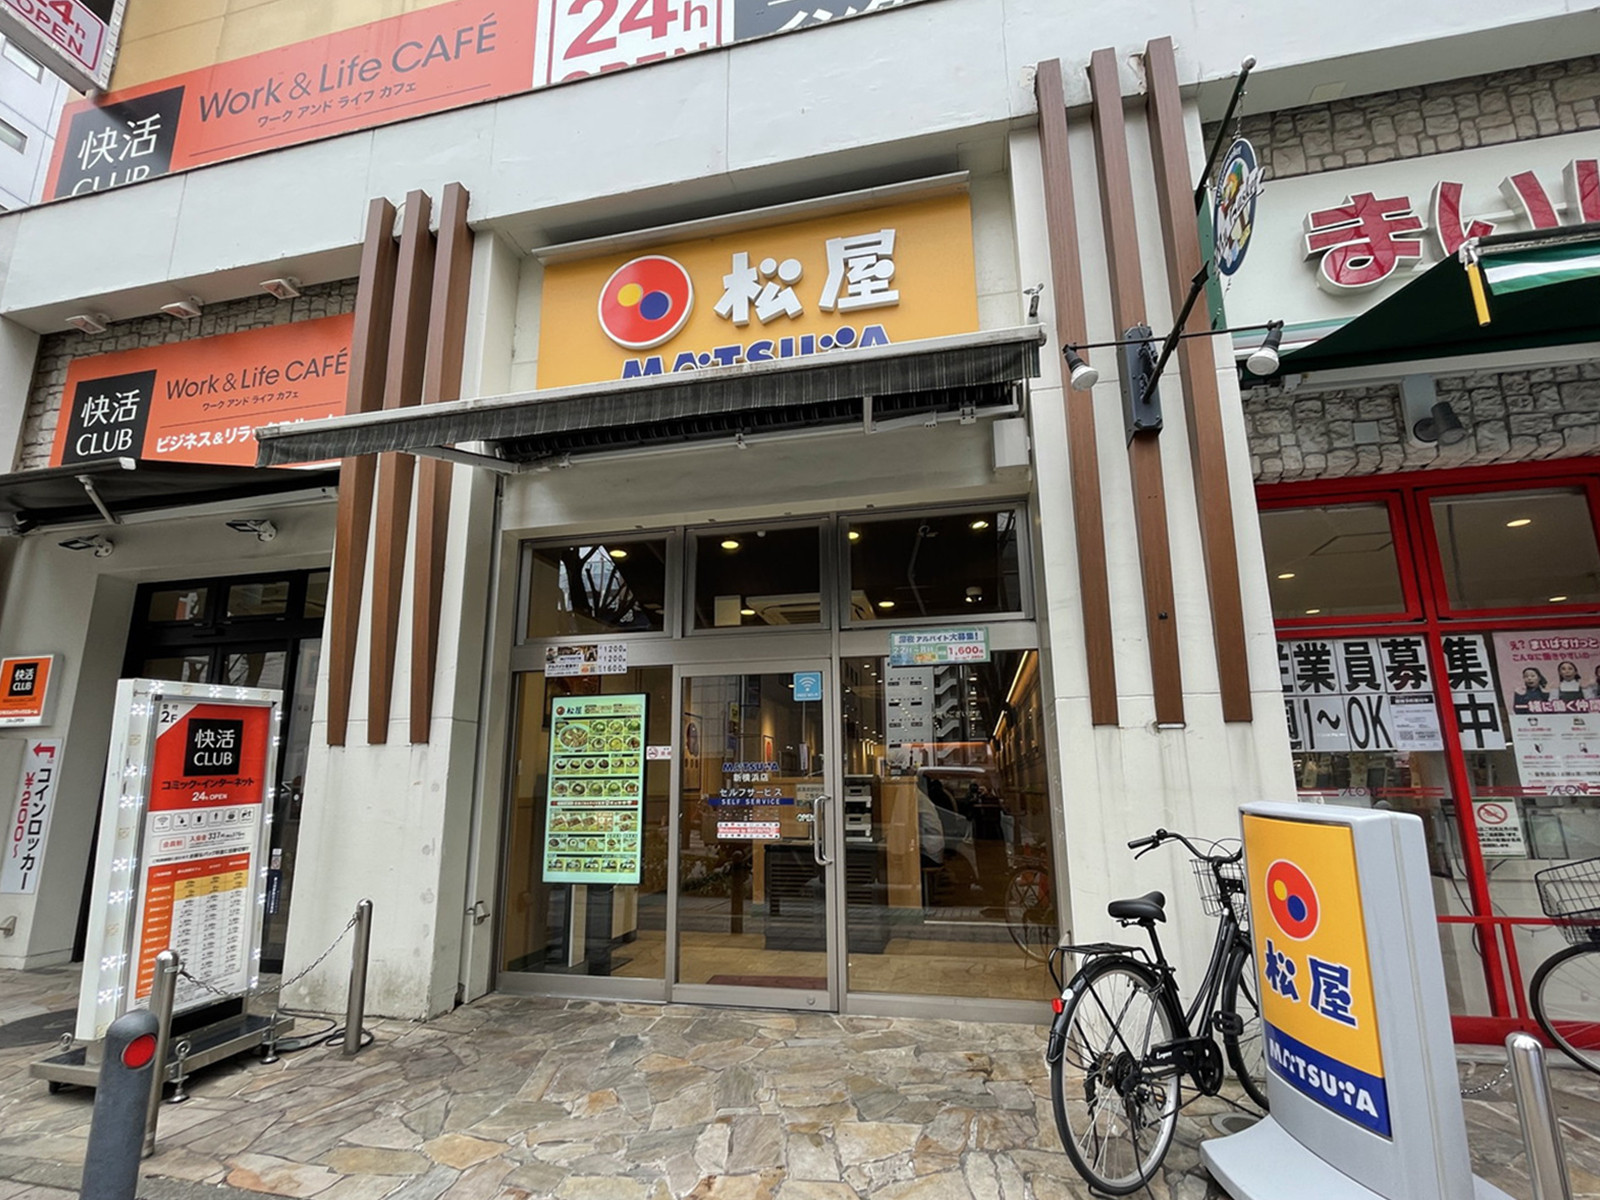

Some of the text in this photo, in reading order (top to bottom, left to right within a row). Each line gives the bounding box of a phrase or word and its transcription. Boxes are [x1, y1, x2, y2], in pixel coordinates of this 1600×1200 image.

[17, 0, 83, 55] OPEN
[36, 0, 86, 39] 4h
[563, 0, 708, 60] 24h
[200, 12, 497, 122] Work & Life CAFÉ
[258, 82, 416, 127] ワーク アンド ライフ カフェ
[77, 113, 161, 171] 快活
[1303, 158, 1600, 296] まい
[713, 228, 901, 328] 松屋
[166, 347, 348, 400] Work & Life CAFÉ
[80, 389, 140, 427] 快活
[202, 390, 299, 412] ワーク アンド ライフ カフェ
[76, 428, 132, 456] CLUB
[161, 710, 178, 723] 2F
[194, 728, 235, 749] 快活
[193, 751, 233, 766] CLUB
[733, 773, 769, 782] 新横浜店
[720, 788, 782, 797] セルフサービス
[20, 768, 52, 891] コインロッカー
[1264, 939, 1359, 1029] 松屋
[1269, 1037, 1379, 1119] MATSUYA
